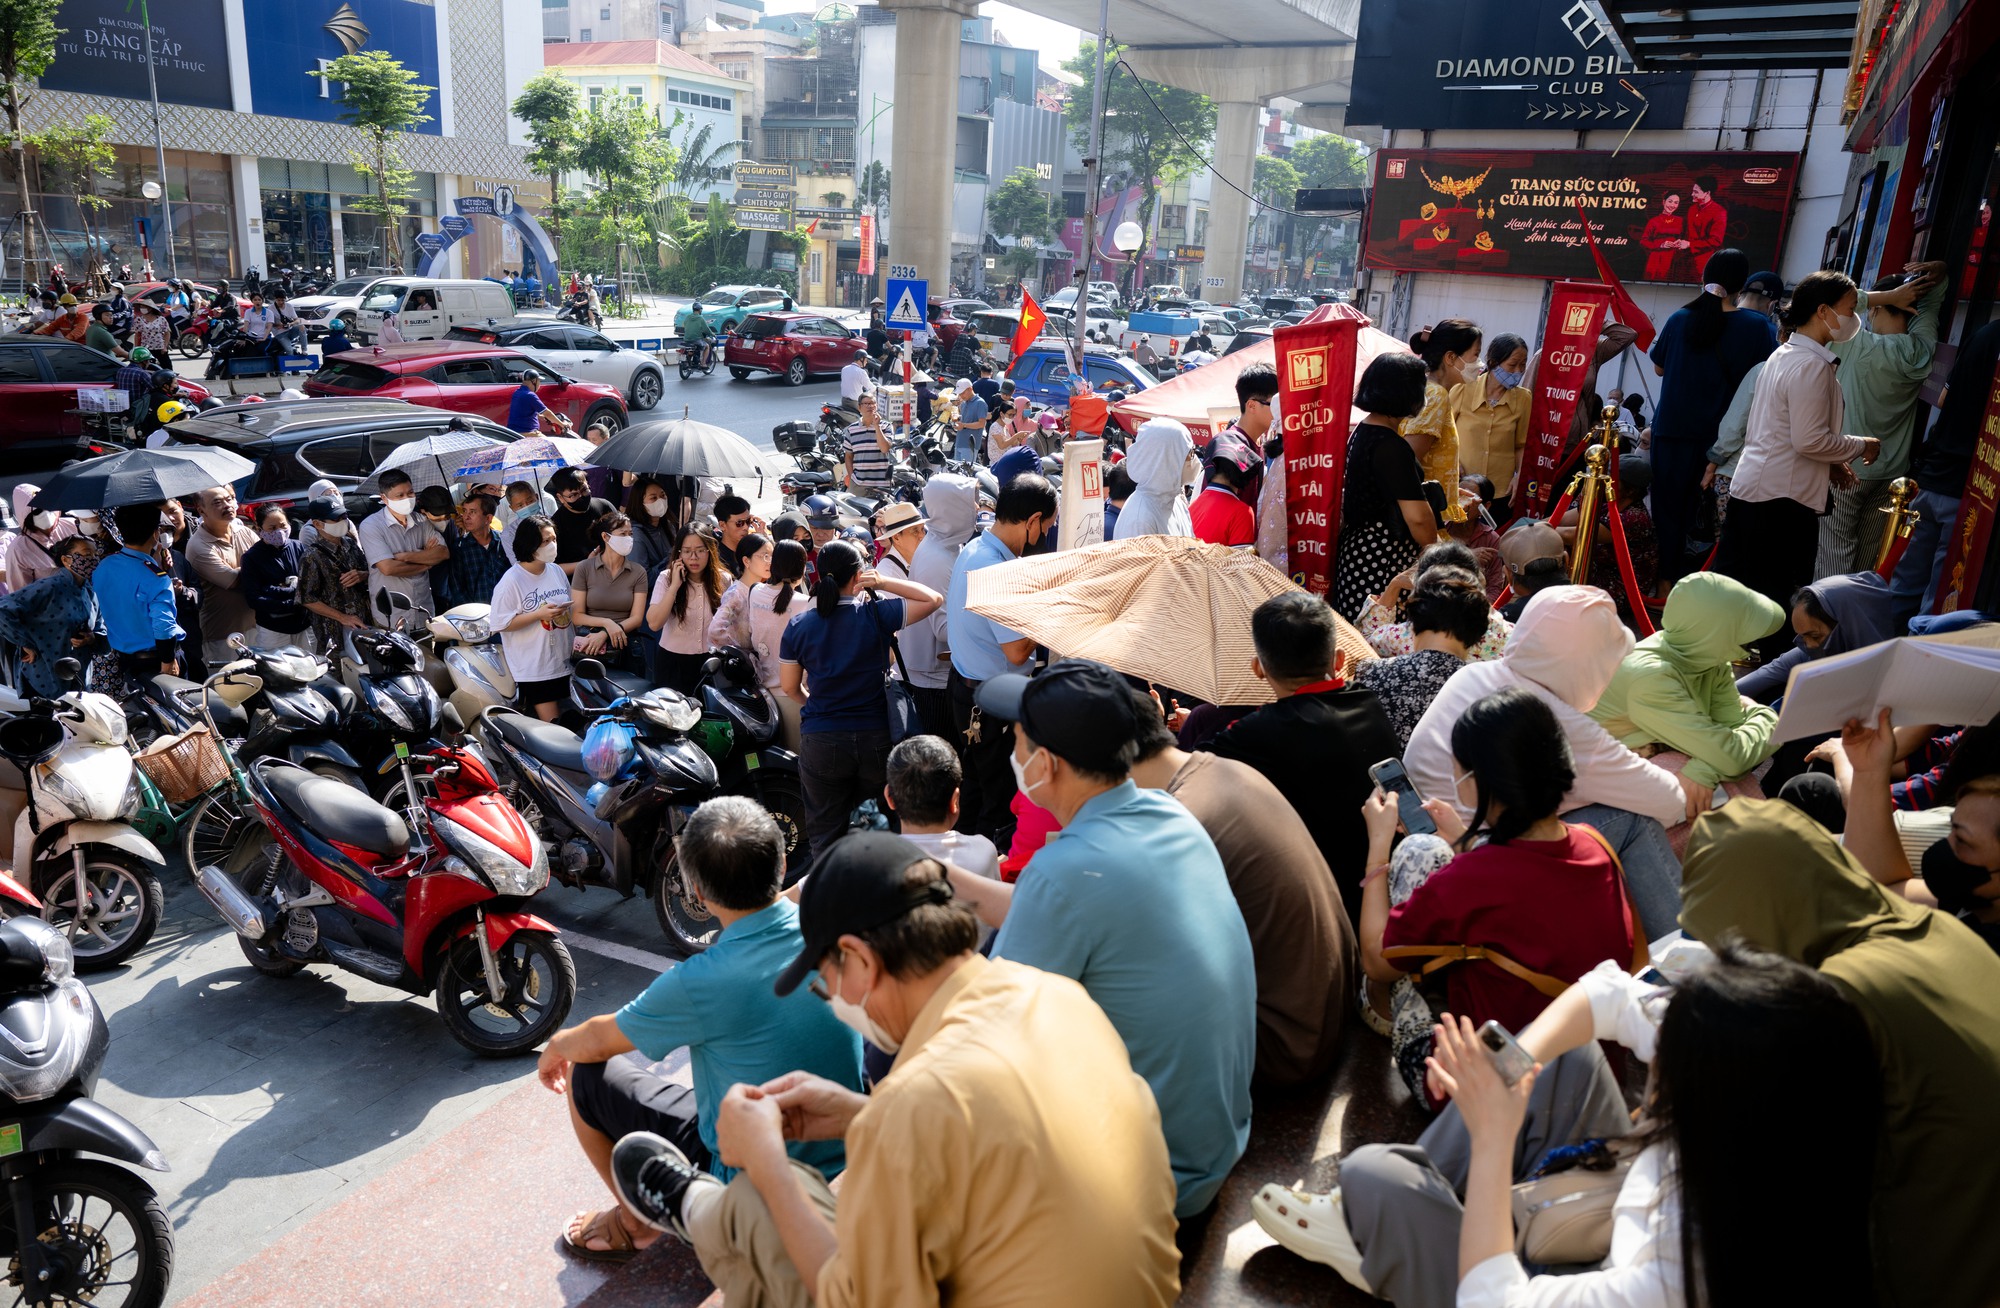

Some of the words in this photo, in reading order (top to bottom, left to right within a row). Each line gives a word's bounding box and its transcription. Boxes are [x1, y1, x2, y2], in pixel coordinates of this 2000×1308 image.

[98, 17, 116, 26] KIM
[151, 25, 166, 36] PNJ
[84, 28, 141, 50] ĐẲNG
[149, 38, 182, 57] CẤP
[61, 43, 78, 54] TỪ
[84, 46, 107, 58] GIÁ
[138, 54, 169, 67] ĐCH
[173, 59, 206, 73] THỰC
[1435, 56, 1575, 78] DIAMOND
[1548, 81, 1604, 95] CLUB
[751, 167, 767, 175] GIAY
[767, 168, 789, 176] HOTEL
[474, 180, 492, 196] PNJ
[1510, 178, 1562, 191] TRANG
[1563, 176, 1595, 192] SỨC
[1597, 176, 1640, 195] CƯỚI,
[769, 200, 789, 208] POINT
[1499, 190, 1530, 206] CỦA
[1532, 190, 1560, 207] HỒI
[1562, 192, 1600, 208] MÔN
[1601, 196, 1648, 210] BTMC
[741, 212, 780, 223] MASSAGE
[1531, 217, 1557, 232] phúc
[1550, 233, 1582, 248] vàng
[1580, 235, 1601, 245] vin
[1604, 236, 1628, 245] mãn
[892, 266, 916, 278] P336
[1206, 278, 1225, 287] P337
[1550, 351, 1586, 367] GOLD
[1546, 386, 1576, 401] TRUNG
[1300, 400, 1322, 412] BTMC
[1284, 408, 1334, 431] GOLD
[1302, 426, 1323, 437] CENTER
[654, 786, 673, 794] HONDA
